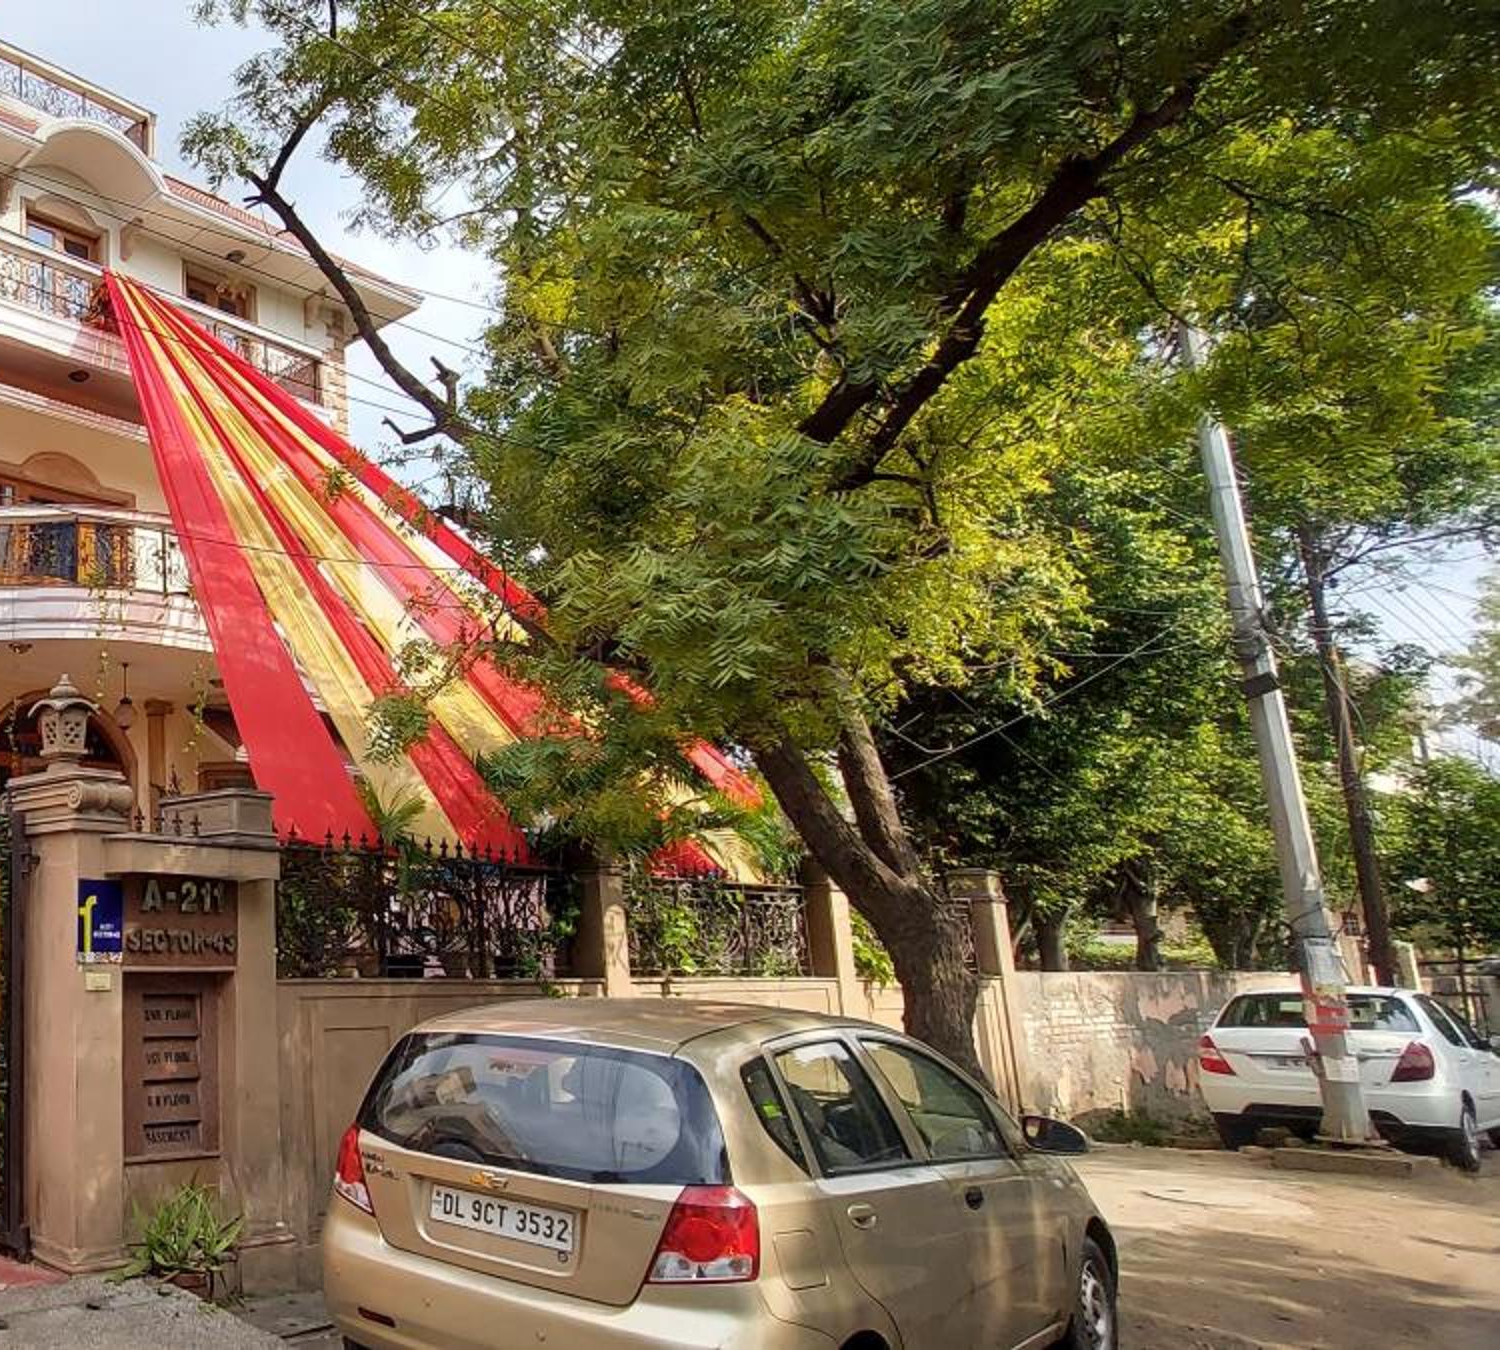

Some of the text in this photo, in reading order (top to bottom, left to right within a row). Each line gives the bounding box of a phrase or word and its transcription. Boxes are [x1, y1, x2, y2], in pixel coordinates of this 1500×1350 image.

[141, 879, 227, 913] A-211
[443, 1192, 466, 1219] DL
[471, 1199, 509, 1228] 9CT
[515, 1209, 570, 1244] 3532
